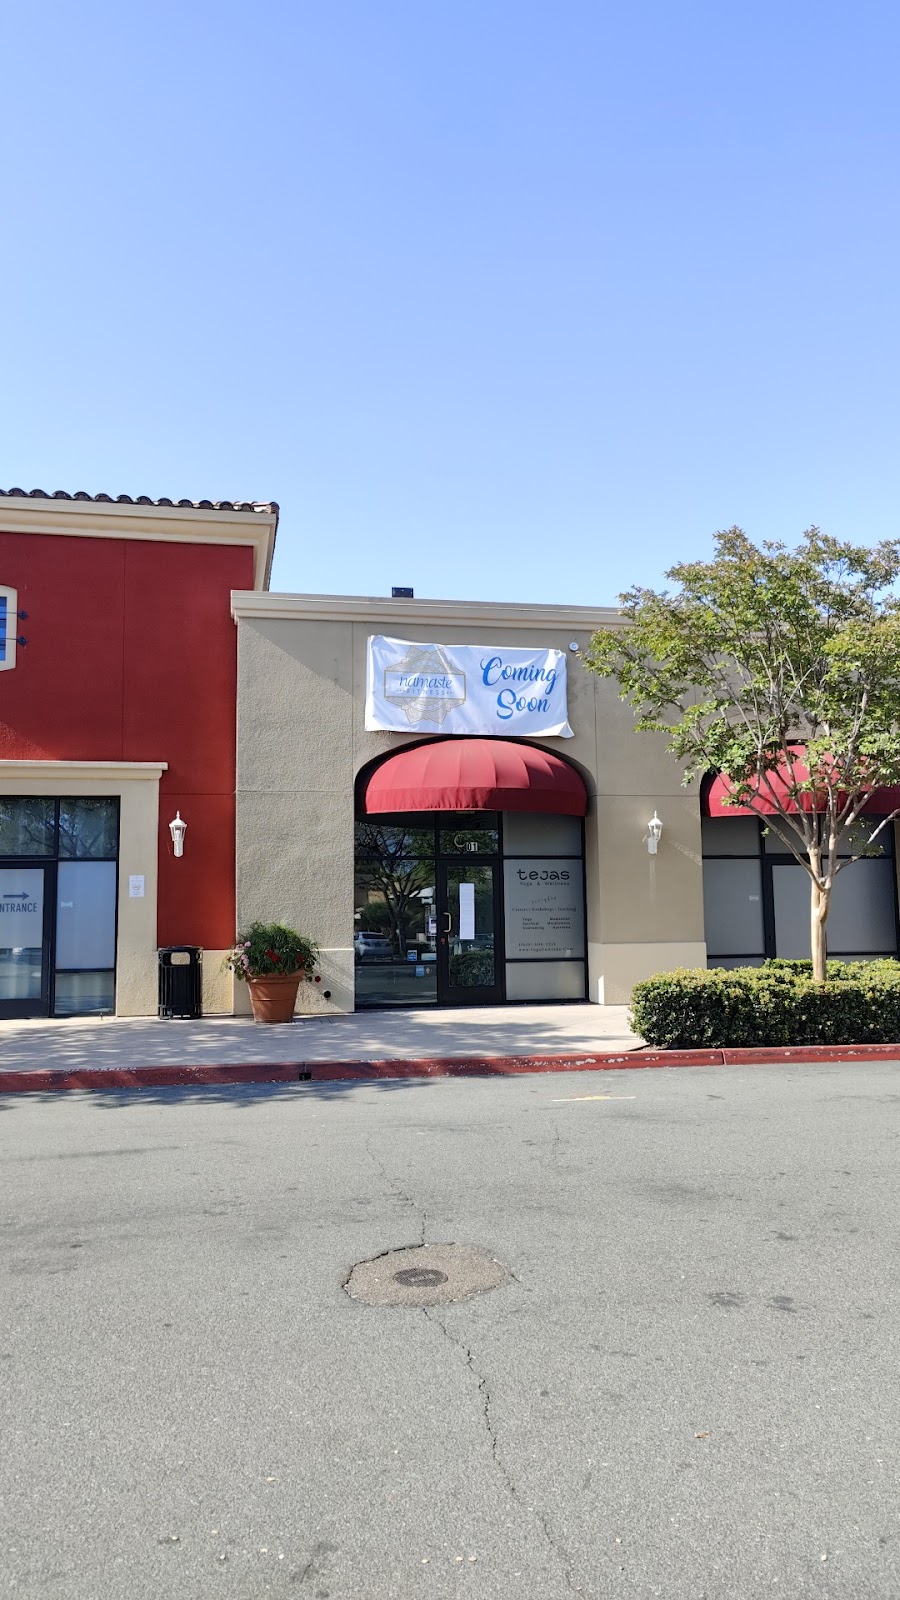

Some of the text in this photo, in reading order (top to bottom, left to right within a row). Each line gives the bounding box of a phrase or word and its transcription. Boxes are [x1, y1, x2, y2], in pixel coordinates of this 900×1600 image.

[480, 656, 560, 695] Coming
[399, 676, 453, 689] namaste
[406, 688, 446, 696] FITNESS
[496, 688, 550, 720] Soon
[516, 868, 570, 881] tejas
